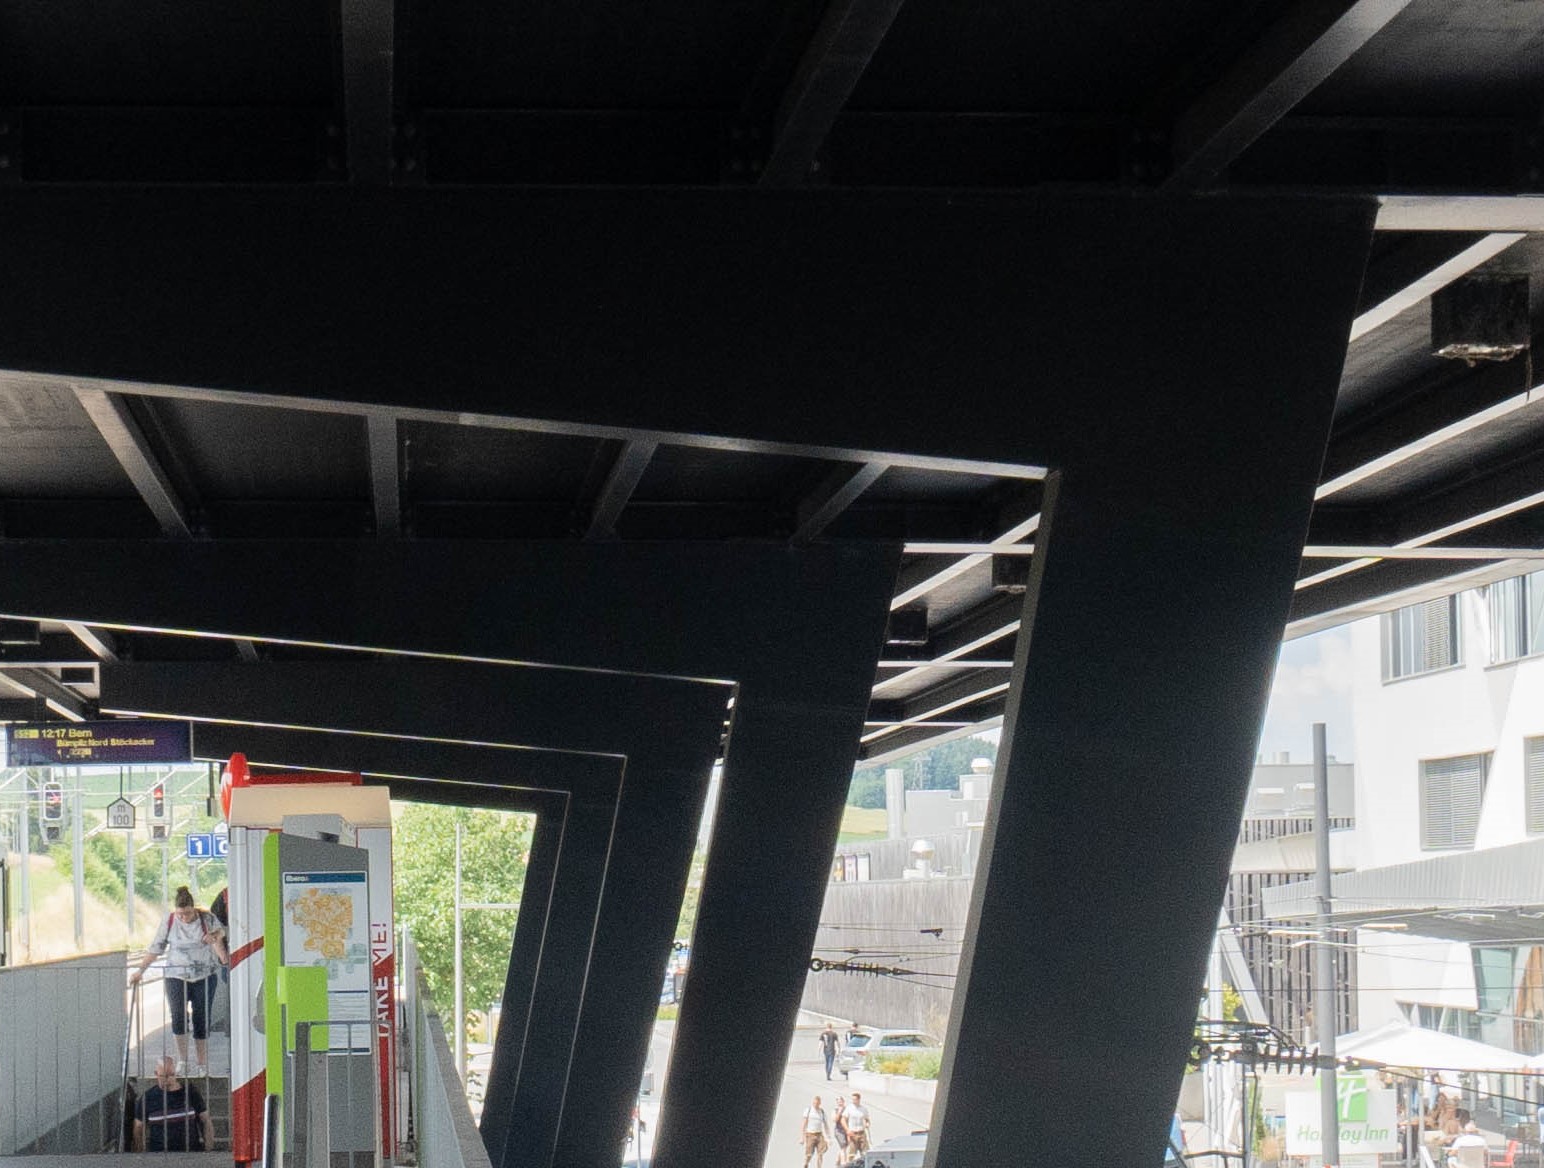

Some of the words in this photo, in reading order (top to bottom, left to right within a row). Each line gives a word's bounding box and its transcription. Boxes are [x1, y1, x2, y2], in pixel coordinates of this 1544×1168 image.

[68, 729, 93, 738] Bern
[112, 814, 130, 826] 100
[195, 841, 203, 855] 1
[1297, 1123, 1362, 1144] Hoay
[1364, 1124, 1389, 1141] Inn
